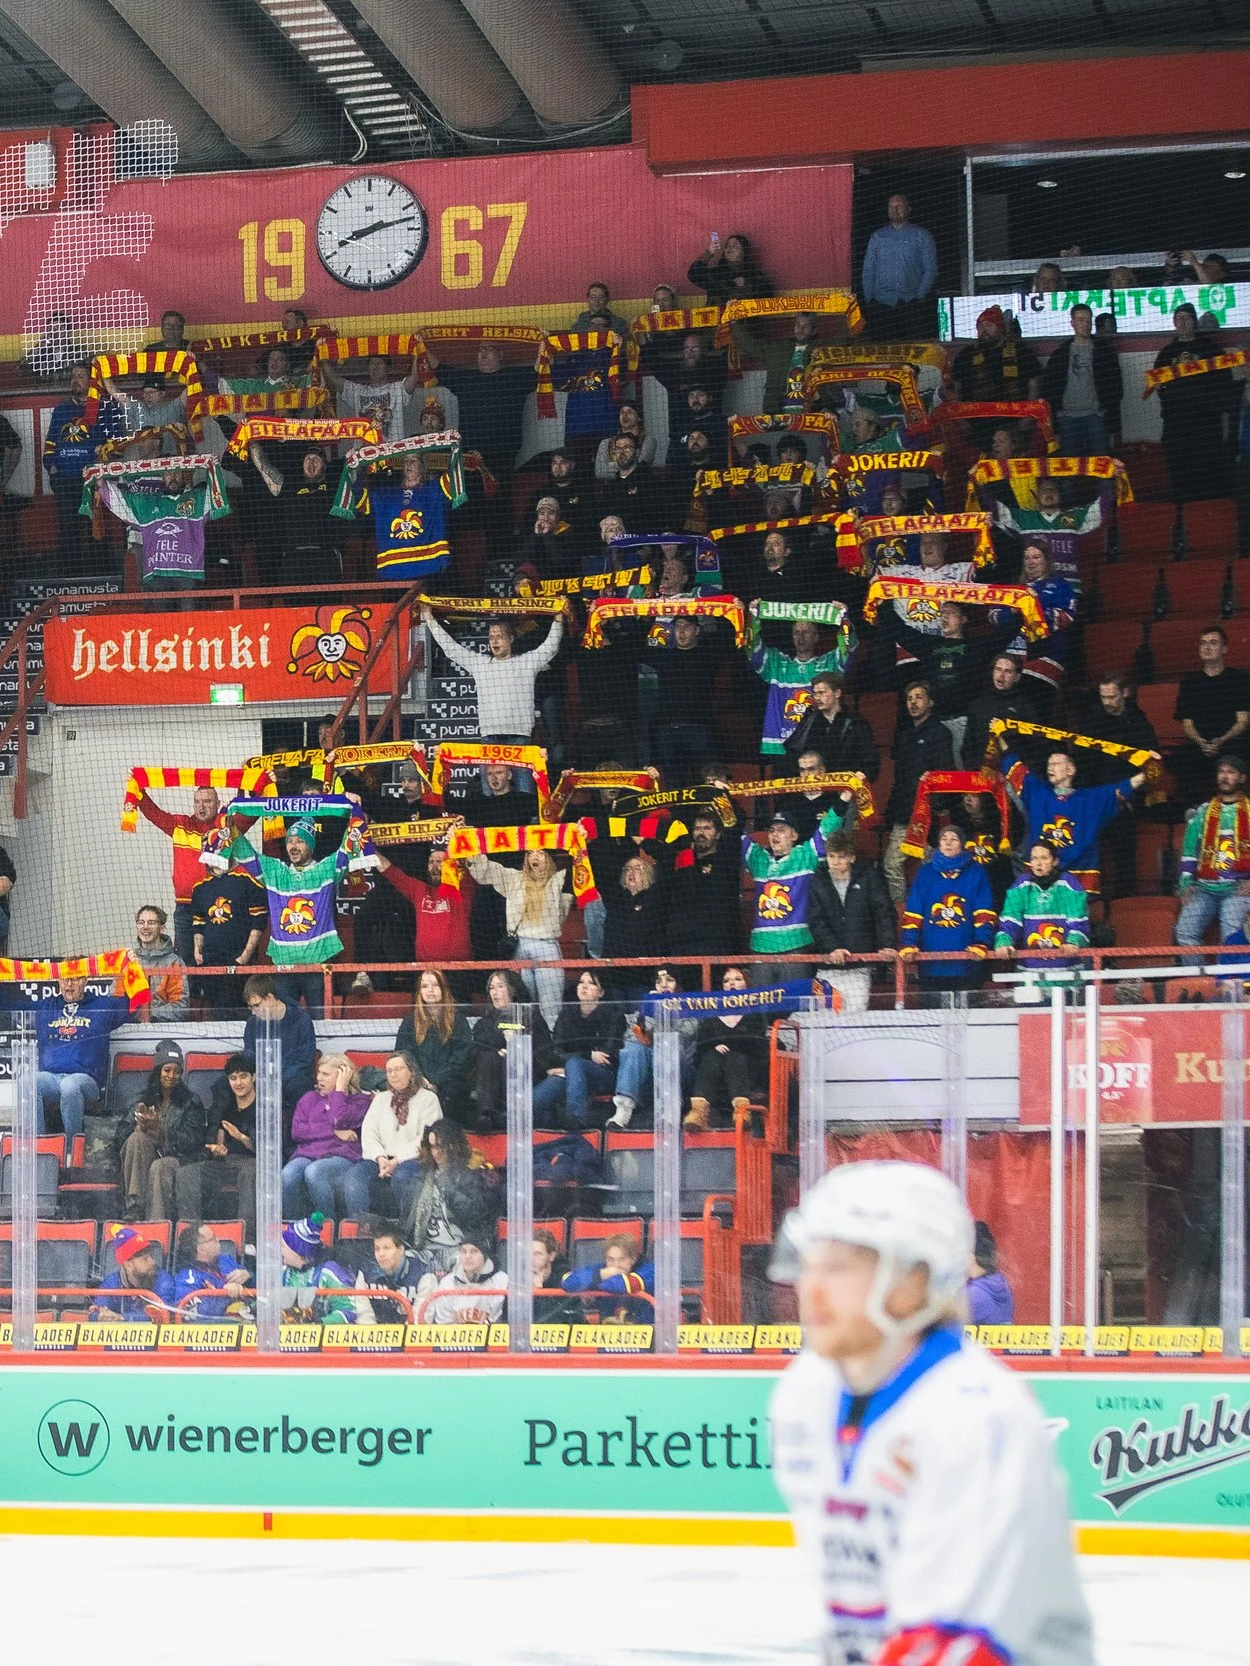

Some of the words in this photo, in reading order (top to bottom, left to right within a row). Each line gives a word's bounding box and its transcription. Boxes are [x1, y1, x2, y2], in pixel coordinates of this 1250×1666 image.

[239, 219, 306, 303] 19
[441, 202, 528, 290] 67
[204, 326, 321, 351] JOKERIT
[848, 450, 930, 472] JOKERIT
[156, 540, 178, 551] TELE
[46, 583, 119, 597] punamusta
[490, 597, 556, 609] HELSINKI
[70, 622, 272, 681] hellsinki
[481, 745, 523, 759] 1967
[263, 798, 323, 812] JOKERIT
[638, 790, 679, 808] JOKERIT
[682, 788, 696, 800] FC
[687, 995, 719, 1010] VAIN
[1067, 1062, 1151, 1089] KOFF
[48, 1421, 101, 1458] W
[125, 1415, 432, 1467] wienerberger
